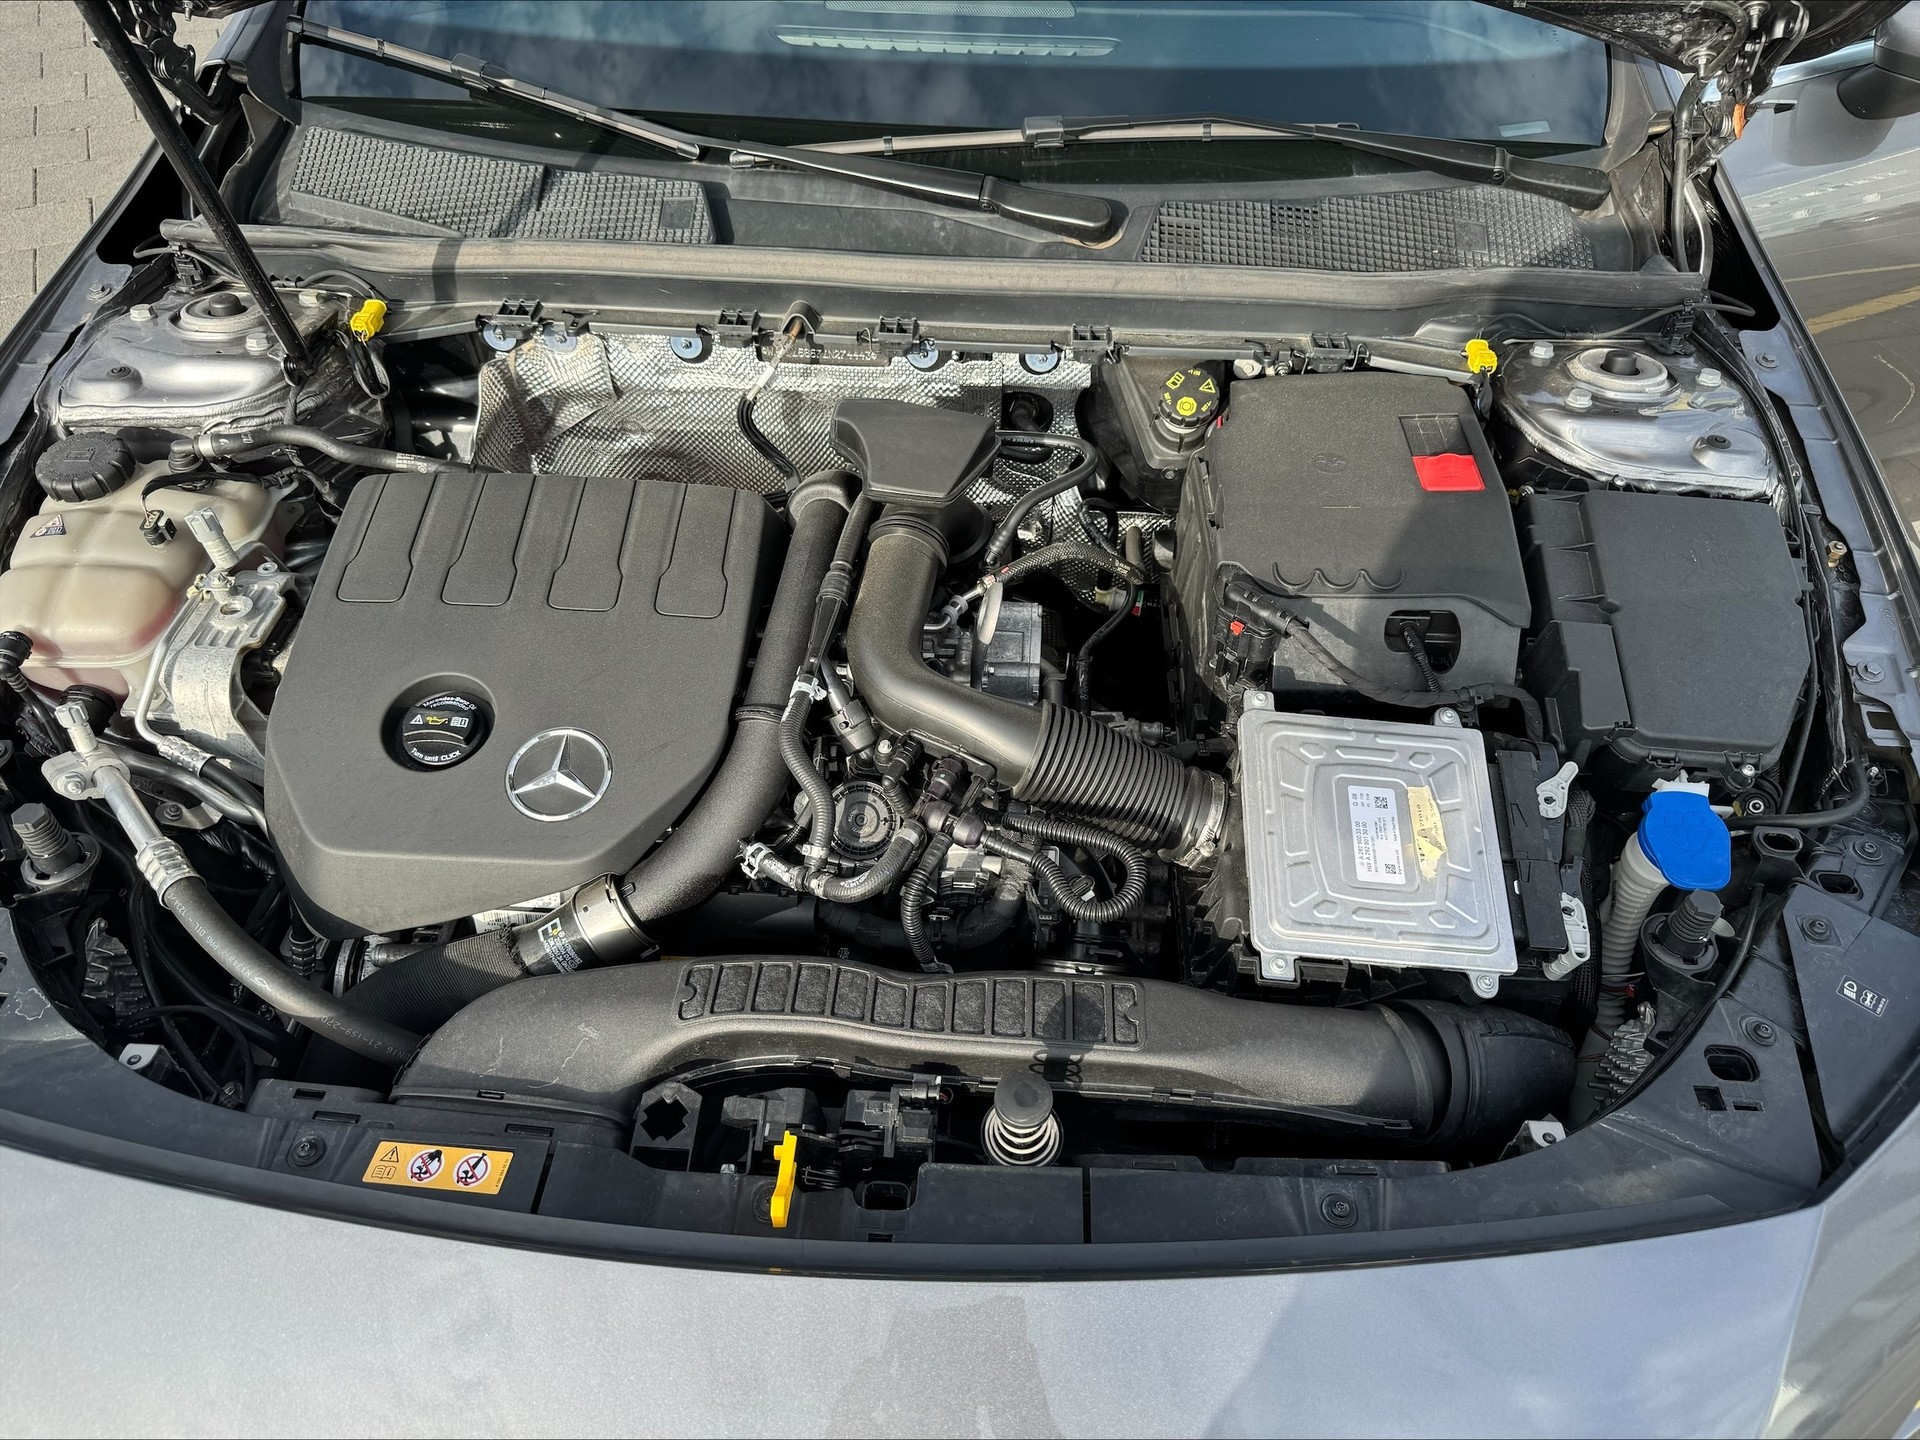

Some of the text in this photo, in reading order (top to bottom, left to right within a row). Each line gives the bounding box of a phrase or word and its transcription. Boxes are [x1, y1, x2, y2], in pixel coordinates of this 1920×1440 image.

[422, 696, 477, 711] Mercedes-Benz Oil
[430, 700, 470, 711] recommended
[410, 747, 423, 759] Turn
[441, 750, 462, 761] CLICK
[194, 922, 206, 936] OIL
[206, 936, 219, 950] PAG
